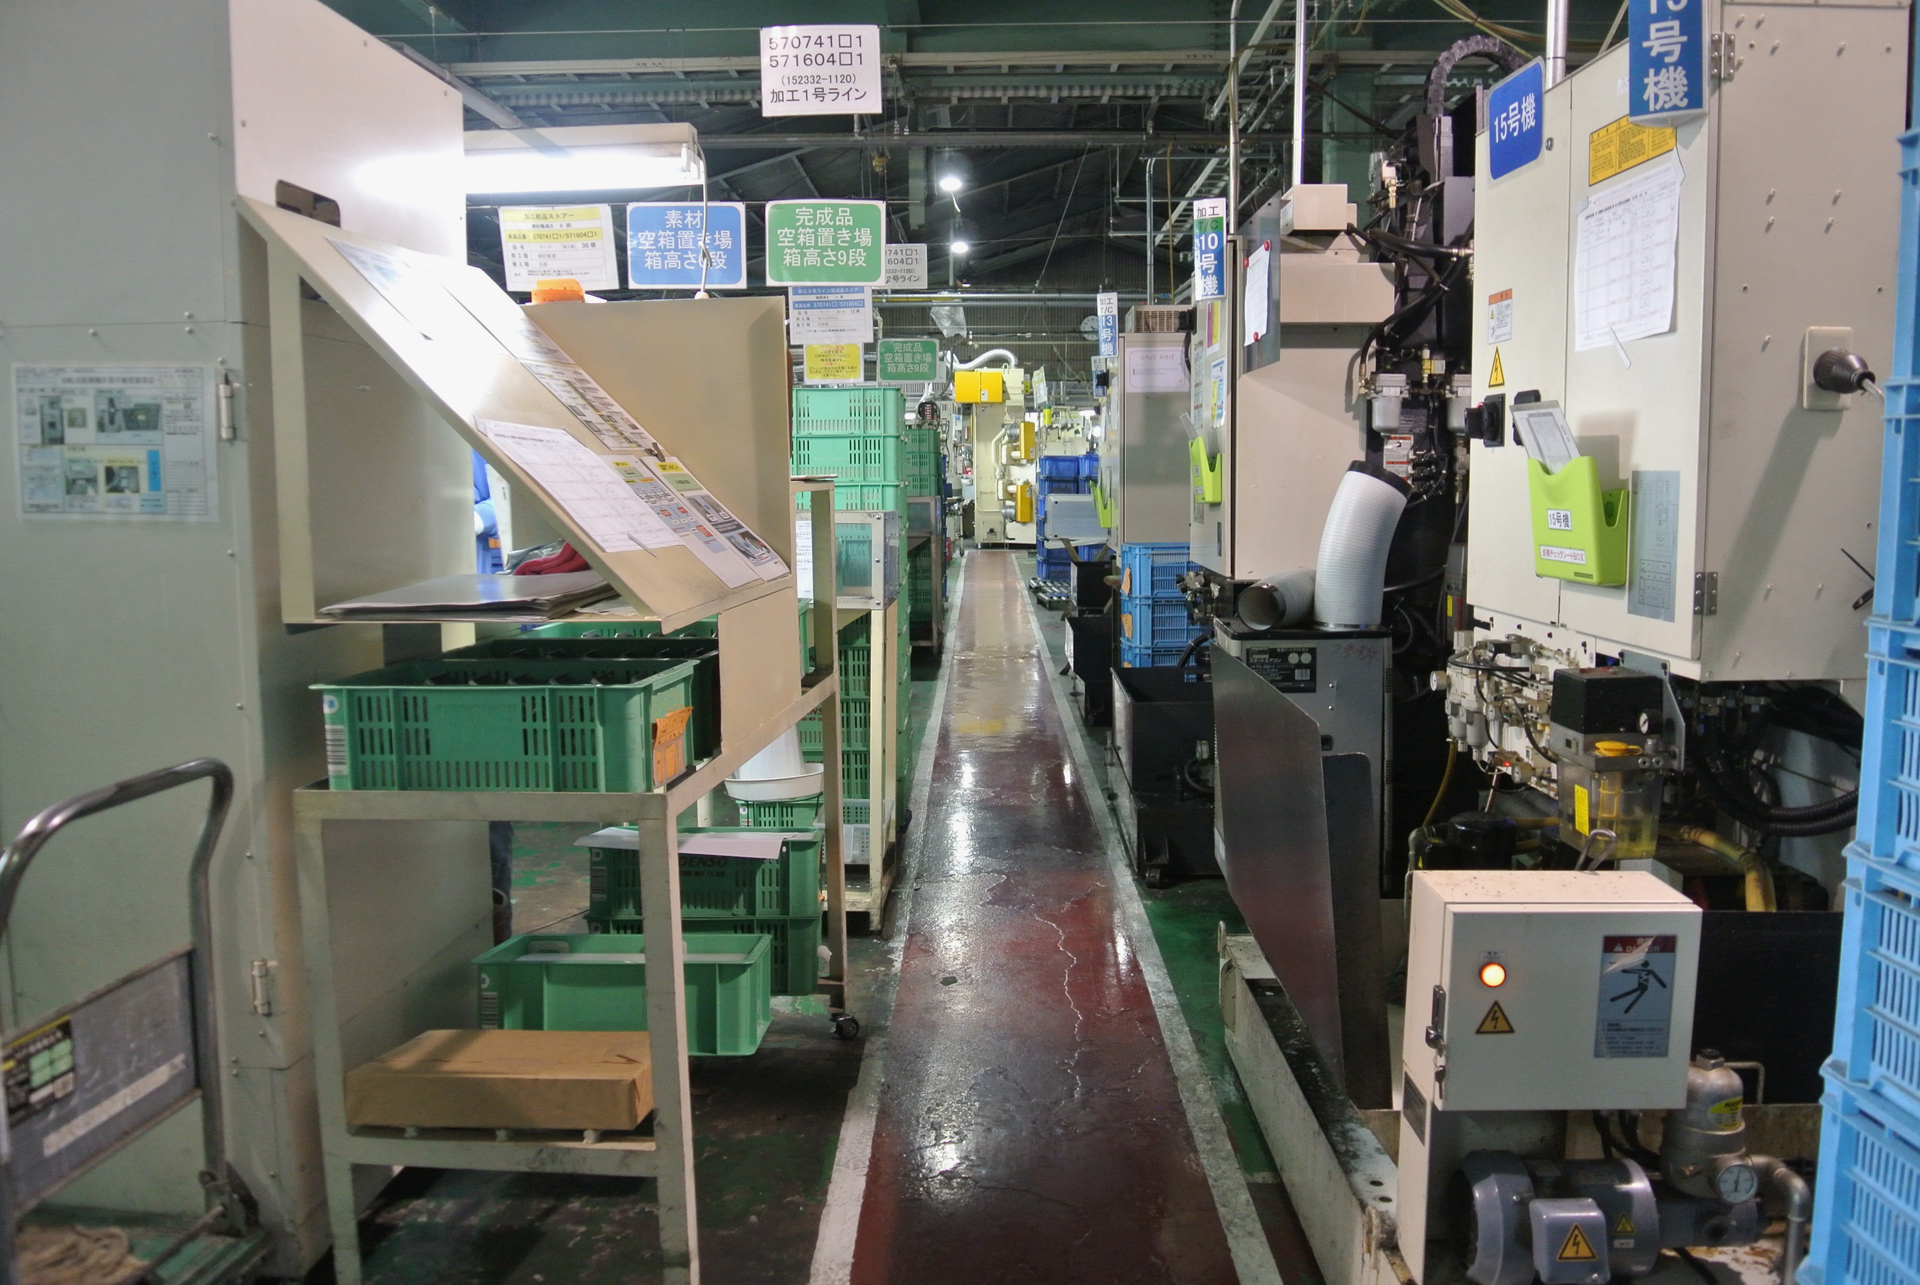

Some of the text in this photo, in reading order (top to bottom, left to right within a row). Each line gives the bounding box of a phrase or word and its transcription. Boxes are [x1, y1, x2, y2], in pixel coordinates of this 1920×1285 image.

[1642, 0, 1688, 111] 号機
[781, 73, 857, 86] (152332-1120)
[770, 87, 867, 103] 加工1号ライン
[1494, 93, 1536, 143] 15号機
[665, 209, 703, 229] 素材
[795, 207, 854, 226] 完成品
[1196, 206, 1220, 218] 加工
[638, 230, 732, 249] 空箱置き場
[777, 227, 873, 247] 空箱置き場
[783, 248, 867, 267] 箱高さ9段
[1200, 233, 1218, 295] 10号機
[1101, 315, 1114, 355] 13号機
[893, 342, 922, 352] 完成品
[883, 353, 932, 363] 空箱置き場
[887, 363, 929, 373] 箱高さ9段
[1549, 512, 1570, 528] 15号機
[679, 856, 728, 867] DENSO
[1625, 945, 1660, 953] DAER
